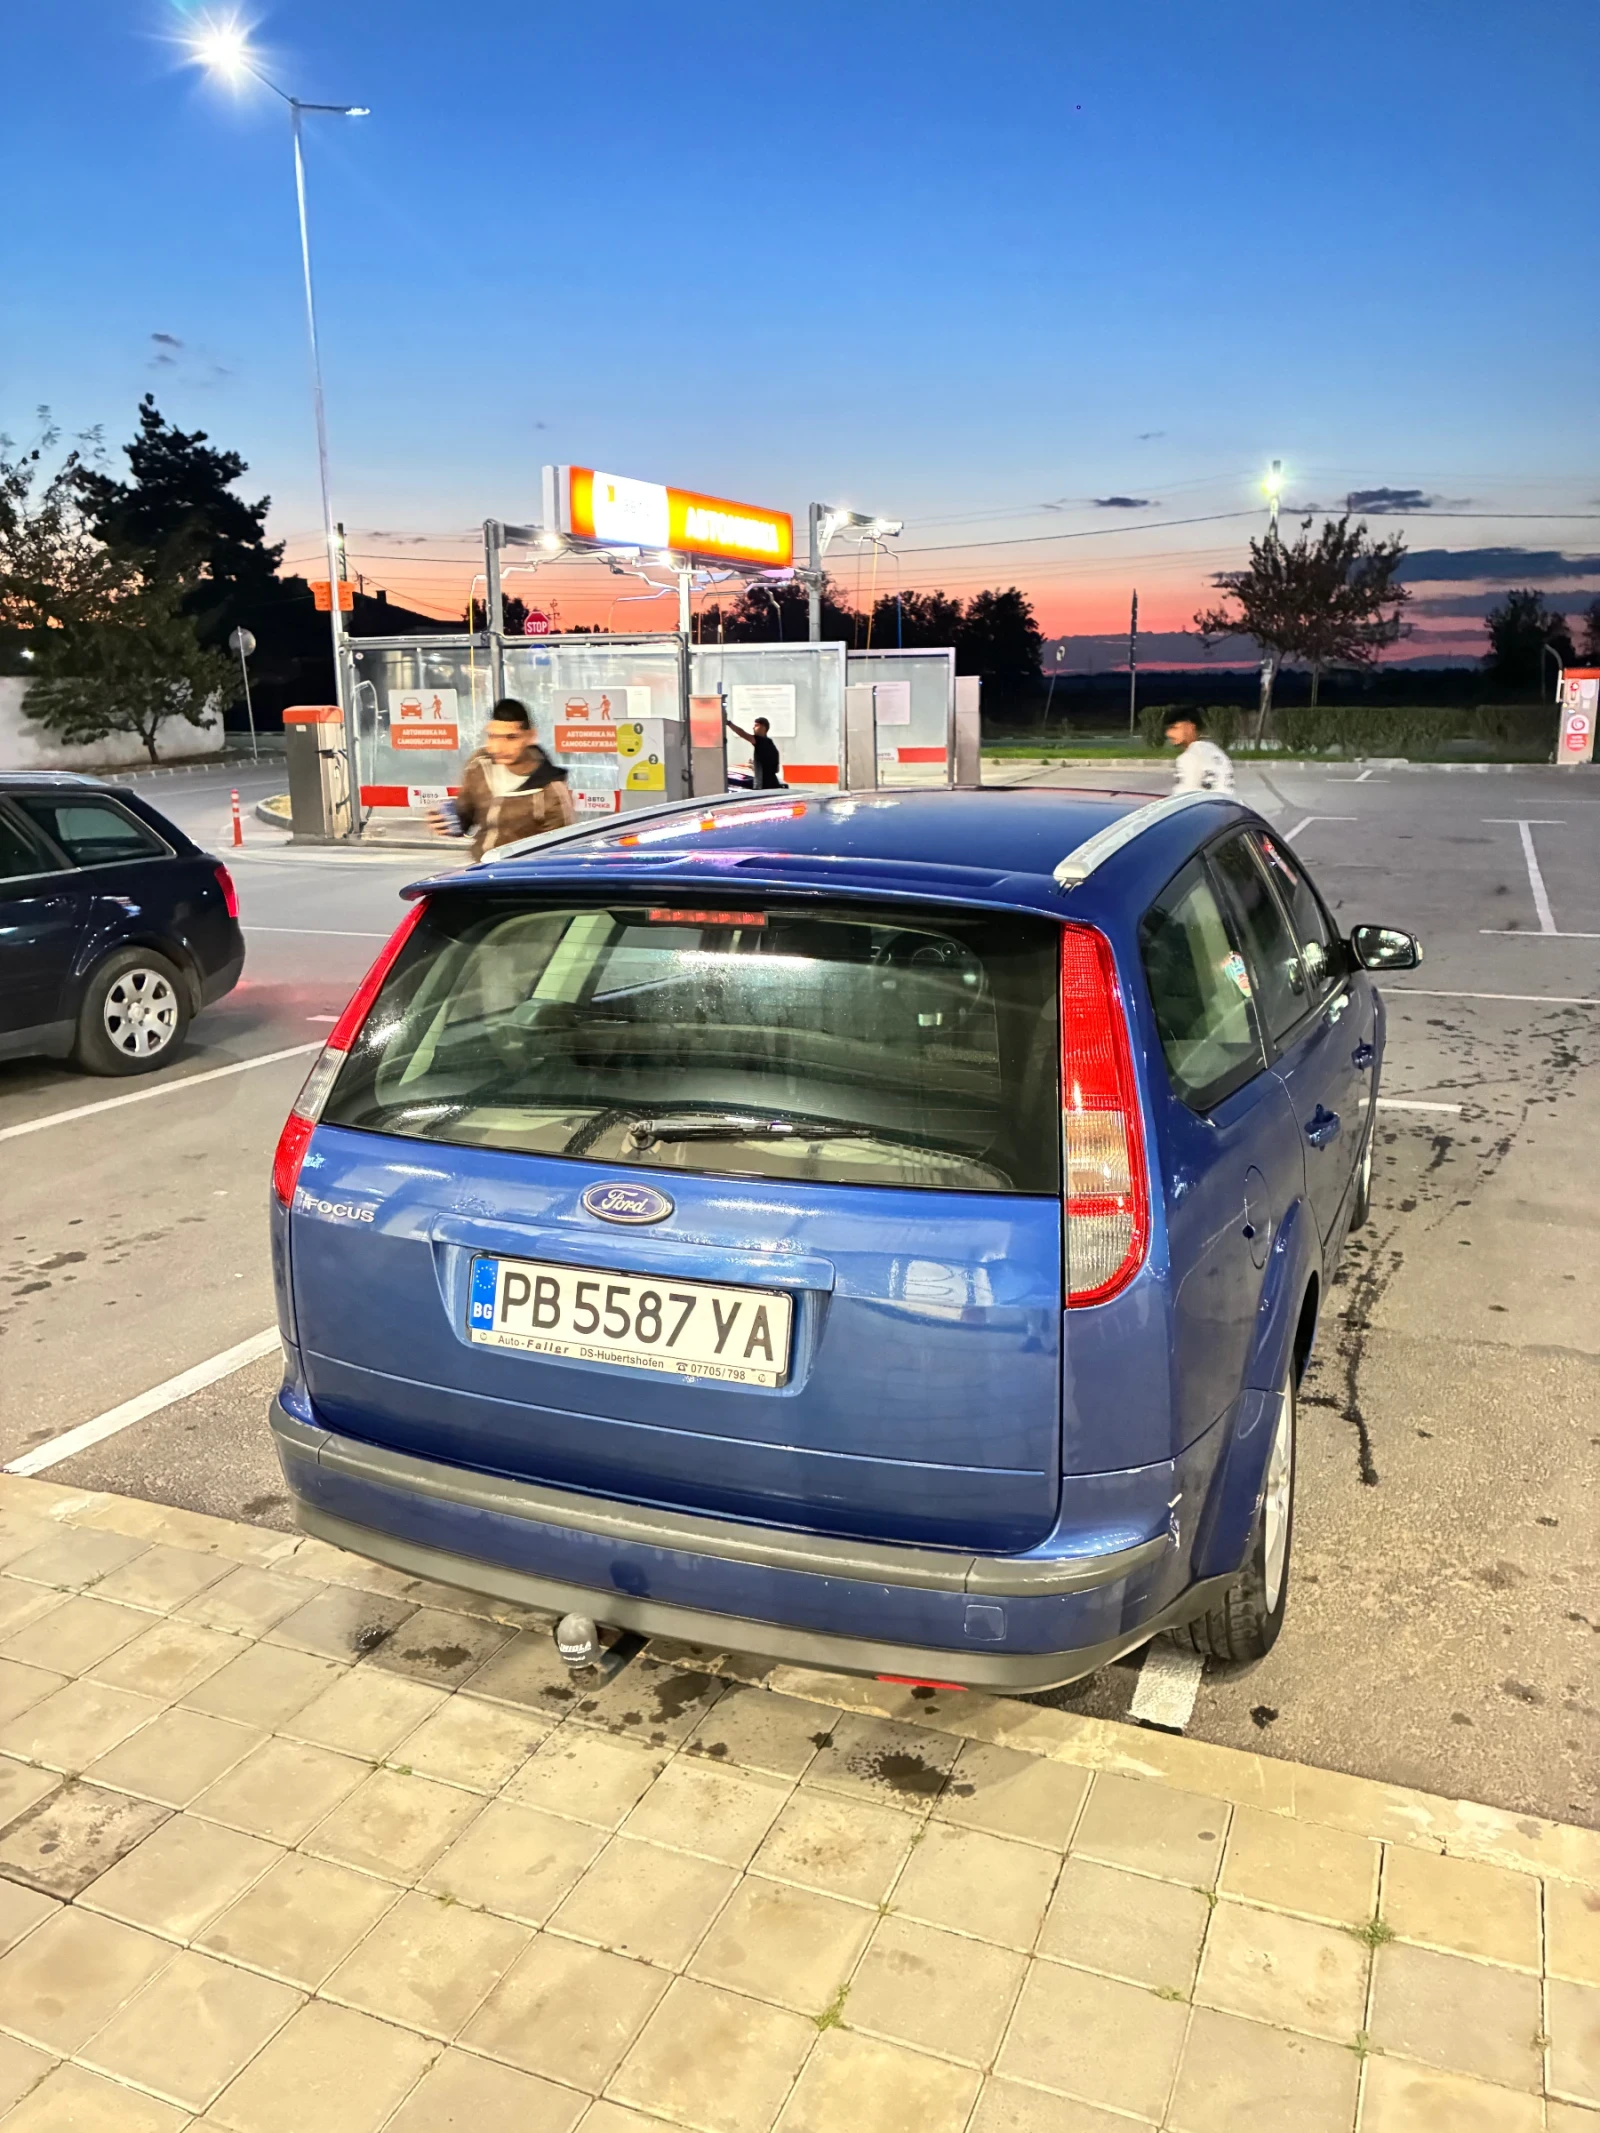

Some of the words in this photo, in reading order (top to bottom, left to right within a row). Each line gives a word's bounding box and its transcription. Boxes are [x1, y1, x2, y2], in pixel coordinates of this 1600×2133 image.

[527, 621, 547, 633] STOP
[305, 1197, 375, 1223] FOCUS
[601, 1189, 649, 1213] Ford
[473, 1302, 493, 1319] BG
[500, 1271, 561, 1329] PB
[573, 1281, 697, 1348] 5587
[711, 1298, 774, 1362] YA
[580, 1347, 664, 1369] DS-Hubertshofen
[690, 1363, 746, 1380] 07705/798
